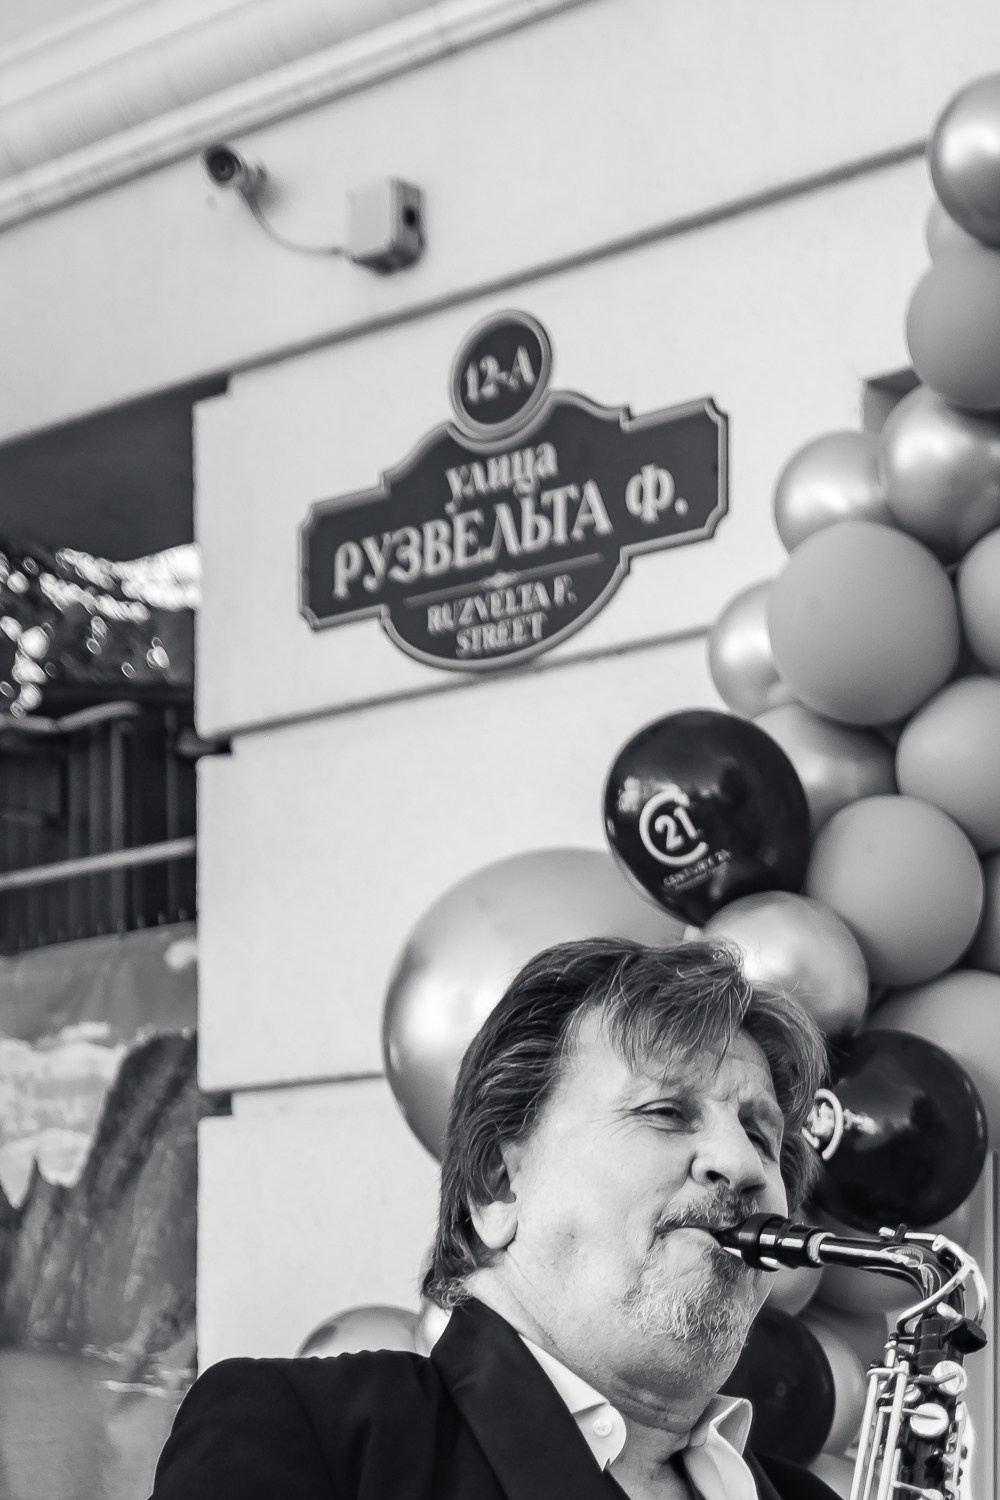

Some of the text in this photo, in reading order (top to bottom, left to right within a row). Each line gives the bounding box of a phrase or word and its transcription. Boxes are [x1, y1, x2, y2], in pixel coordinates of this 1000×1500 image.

[445, 443, 559, 517] улица
[332, 463, 690, 599] РУЗВЕЛЬТА Ф.
[455, 611, 548, 659] STREET
